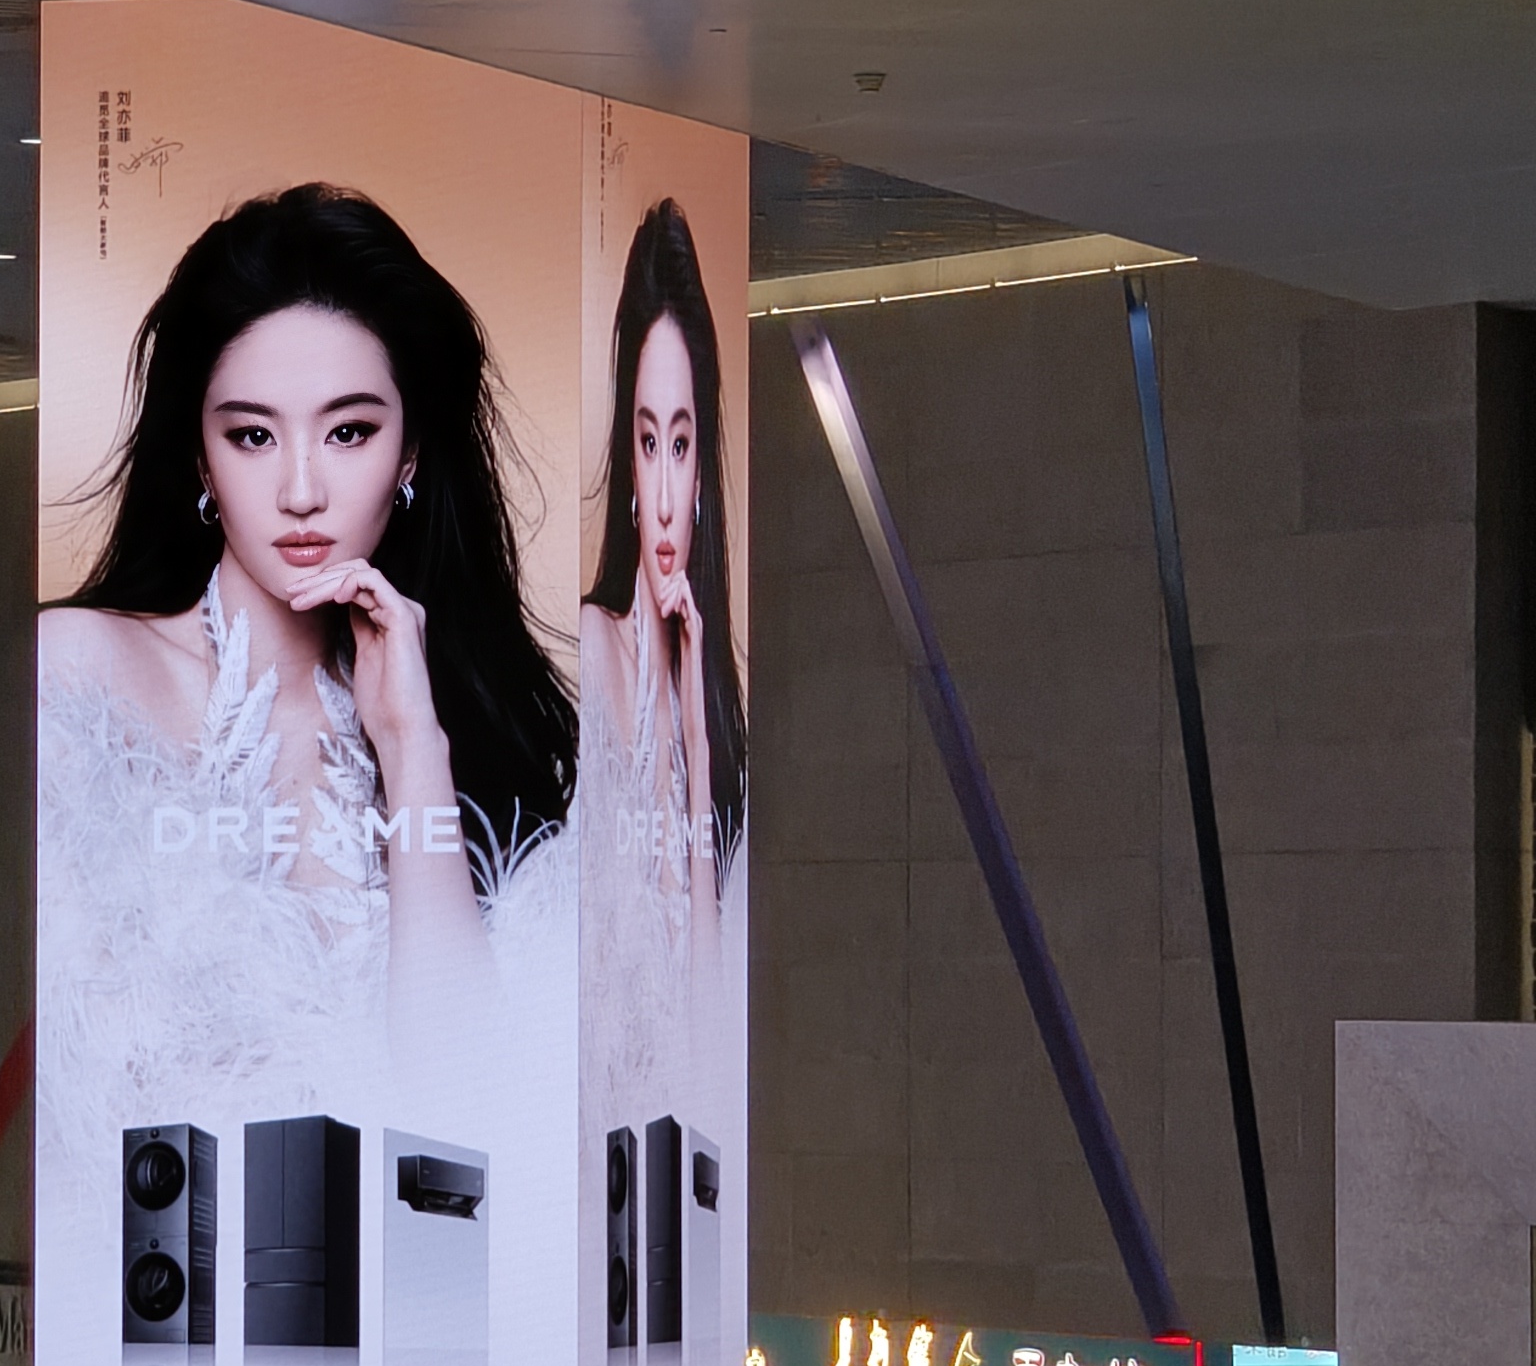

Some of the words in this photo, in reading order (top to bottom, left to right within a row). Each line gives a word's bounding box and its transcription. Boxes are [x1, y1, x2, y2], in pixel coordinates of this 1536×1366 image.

[116, 91, 131, 143] 刘亦菲
[154, 806, 461, 854] DREAME
